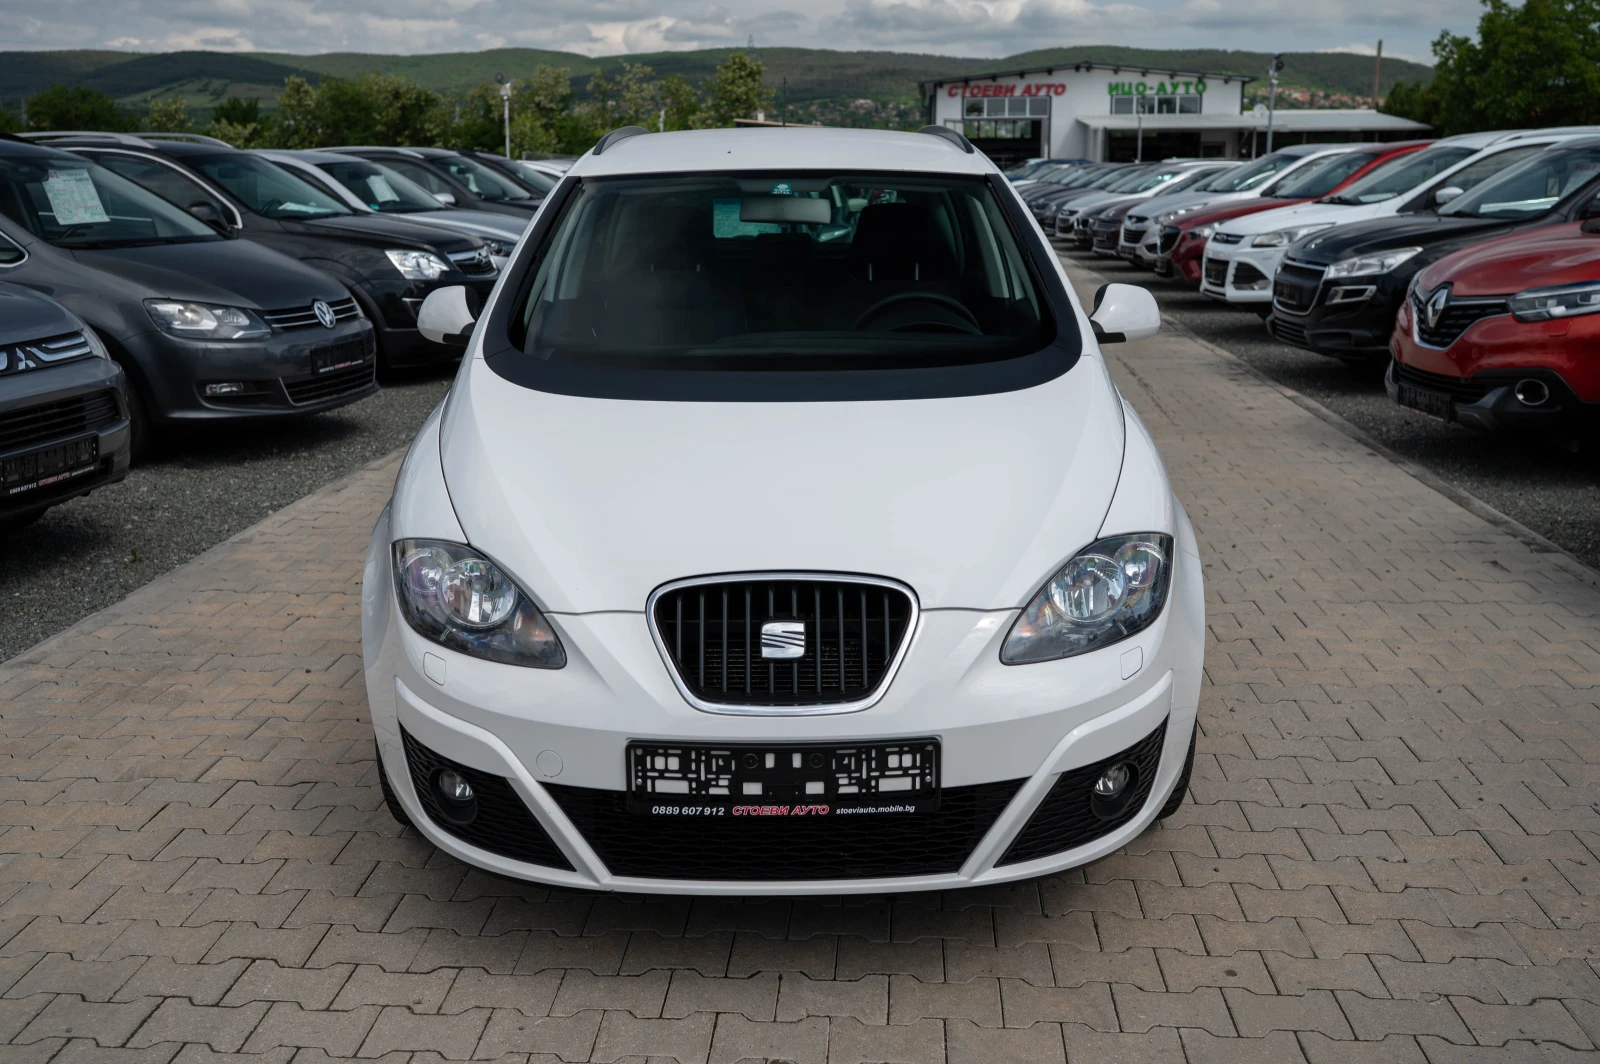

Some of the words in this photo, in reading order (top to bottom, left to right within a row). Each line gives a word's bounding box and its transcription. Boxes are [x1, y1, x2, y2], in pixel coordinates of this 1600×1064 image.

[947, 83, 1016, 98] СТОЕВИ
[1020, 82, 1067, 97] АУТО
[1107, 80, 1207, 96] ИЦО-АУТО
[652, 806, 680, 815] 0889
[681, 806, 702, 815] 607
[703, 807, 725, 816] 912
[732, 805, 790, 816] СТОЕВИ
[791, 804, 830, 815] АУТО
[835, 805, 916, 815] stoeviauto.mobile.bg
